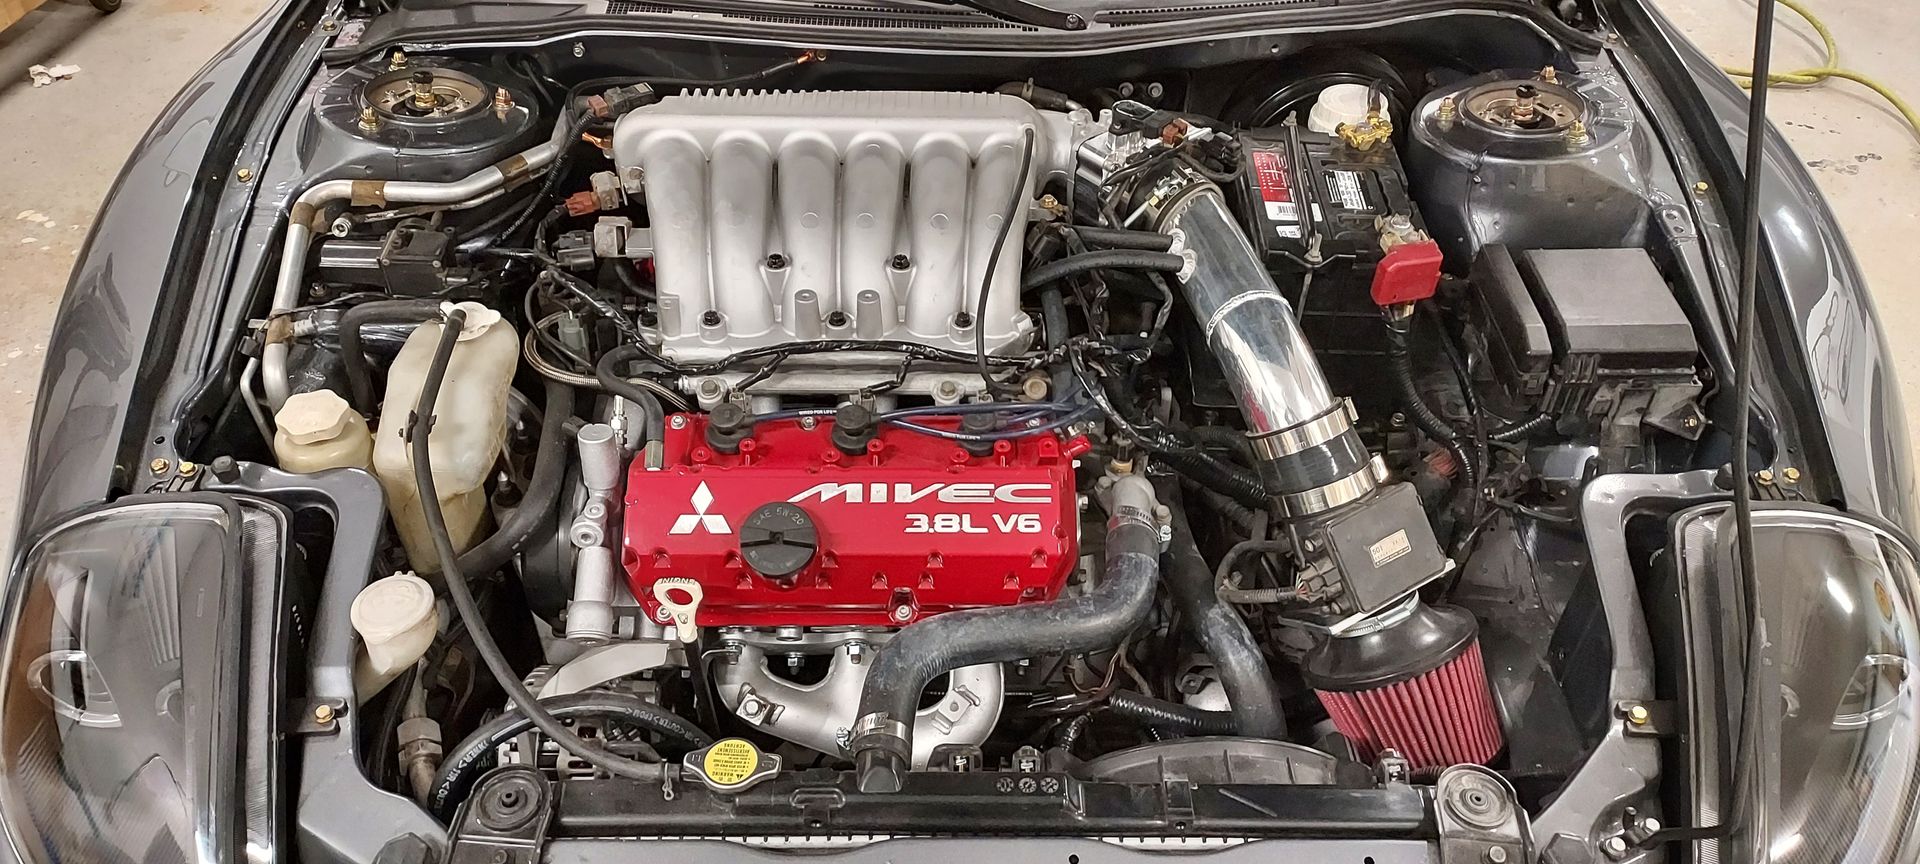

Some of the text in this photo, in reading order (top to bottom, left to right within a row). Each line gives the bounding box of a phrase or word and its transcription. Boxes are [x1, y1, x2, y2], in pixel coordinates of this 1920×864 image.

[787, 482, 1052, 504] MIVEC
[776, 506, 804, 525] 5W-20
[904, 514, 1042, 534] 3.8L V6
